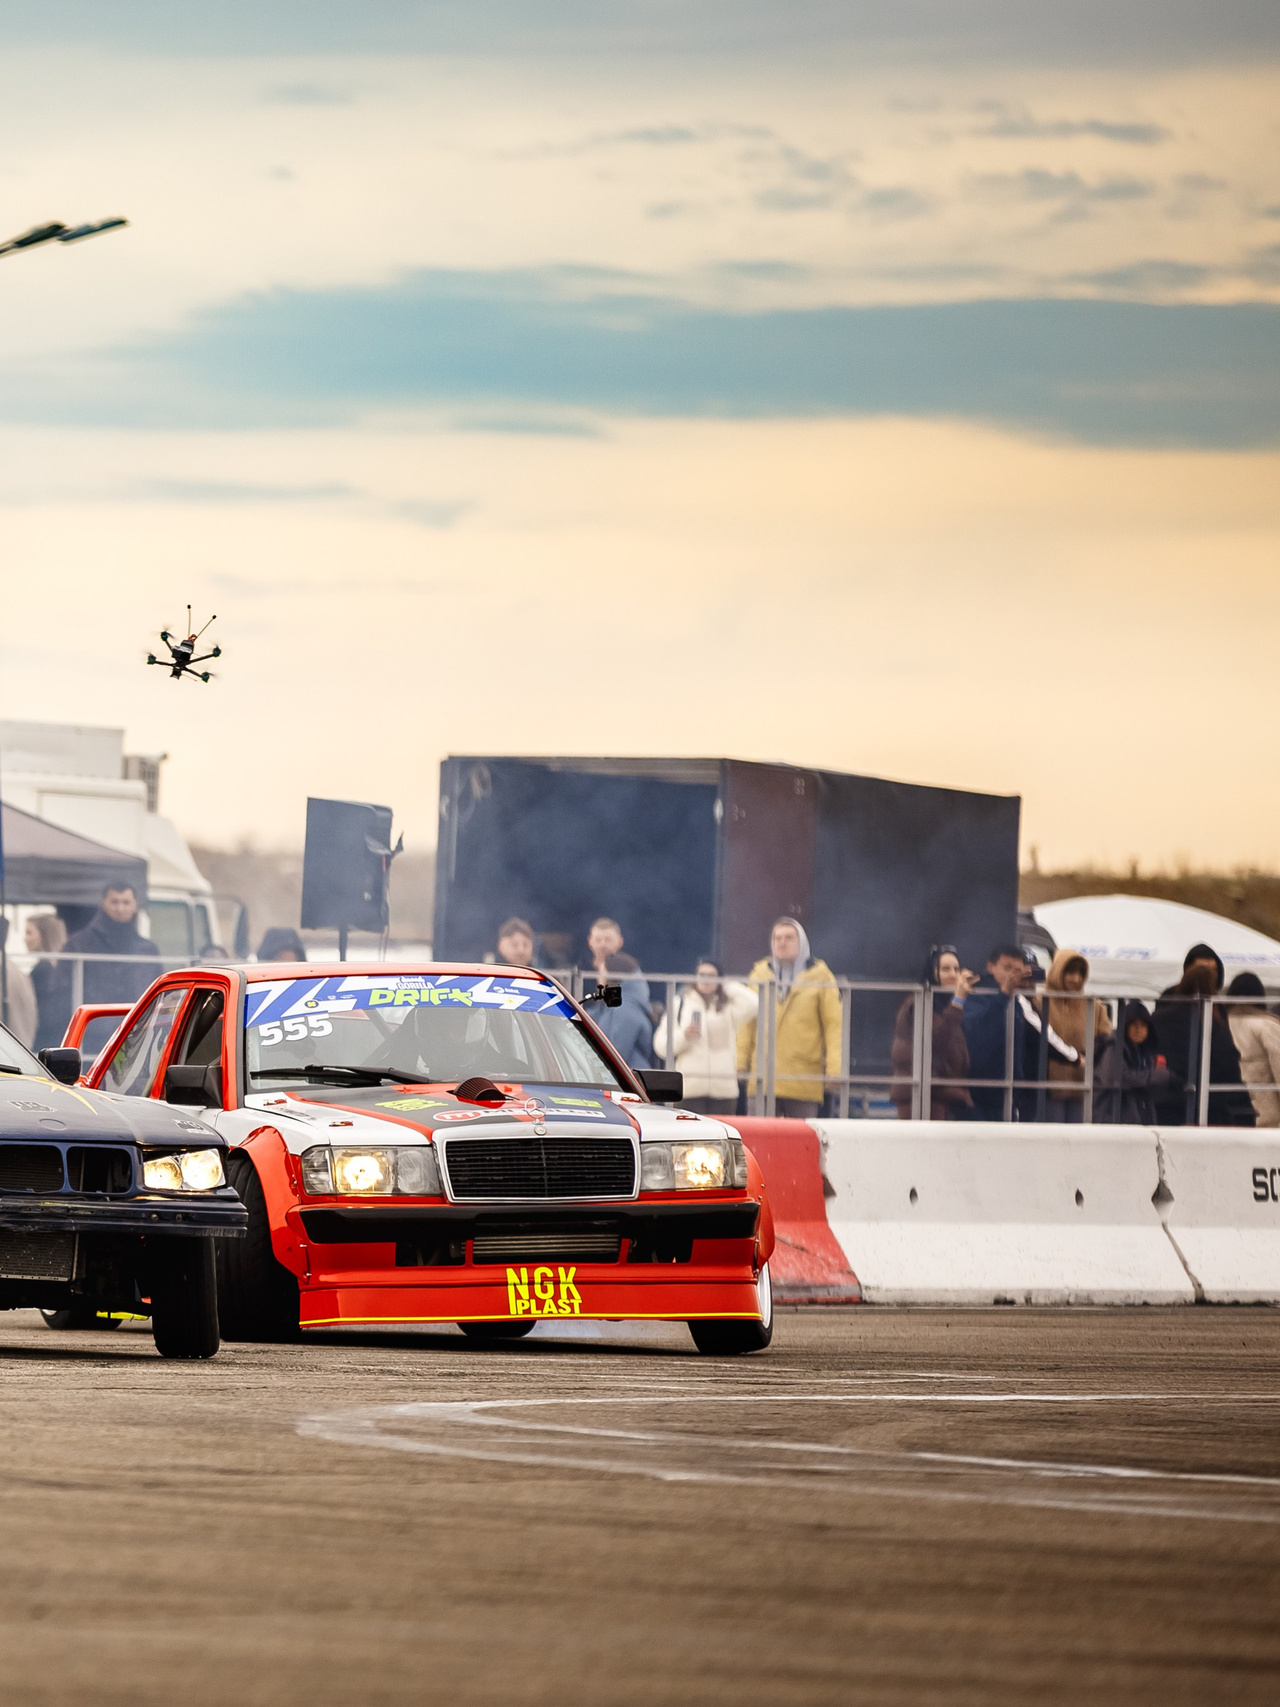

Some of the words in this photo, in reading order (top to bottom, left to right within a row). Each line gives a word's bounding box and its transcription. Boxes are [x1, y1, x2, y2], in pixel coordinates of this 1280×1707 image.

[397, 981, 435, 990] GORILLA
[258, 1013, 333, 1046] 555
[506, 1266, 581, 1315] NGK
[516, 1299, 582, 1315] PLAST
